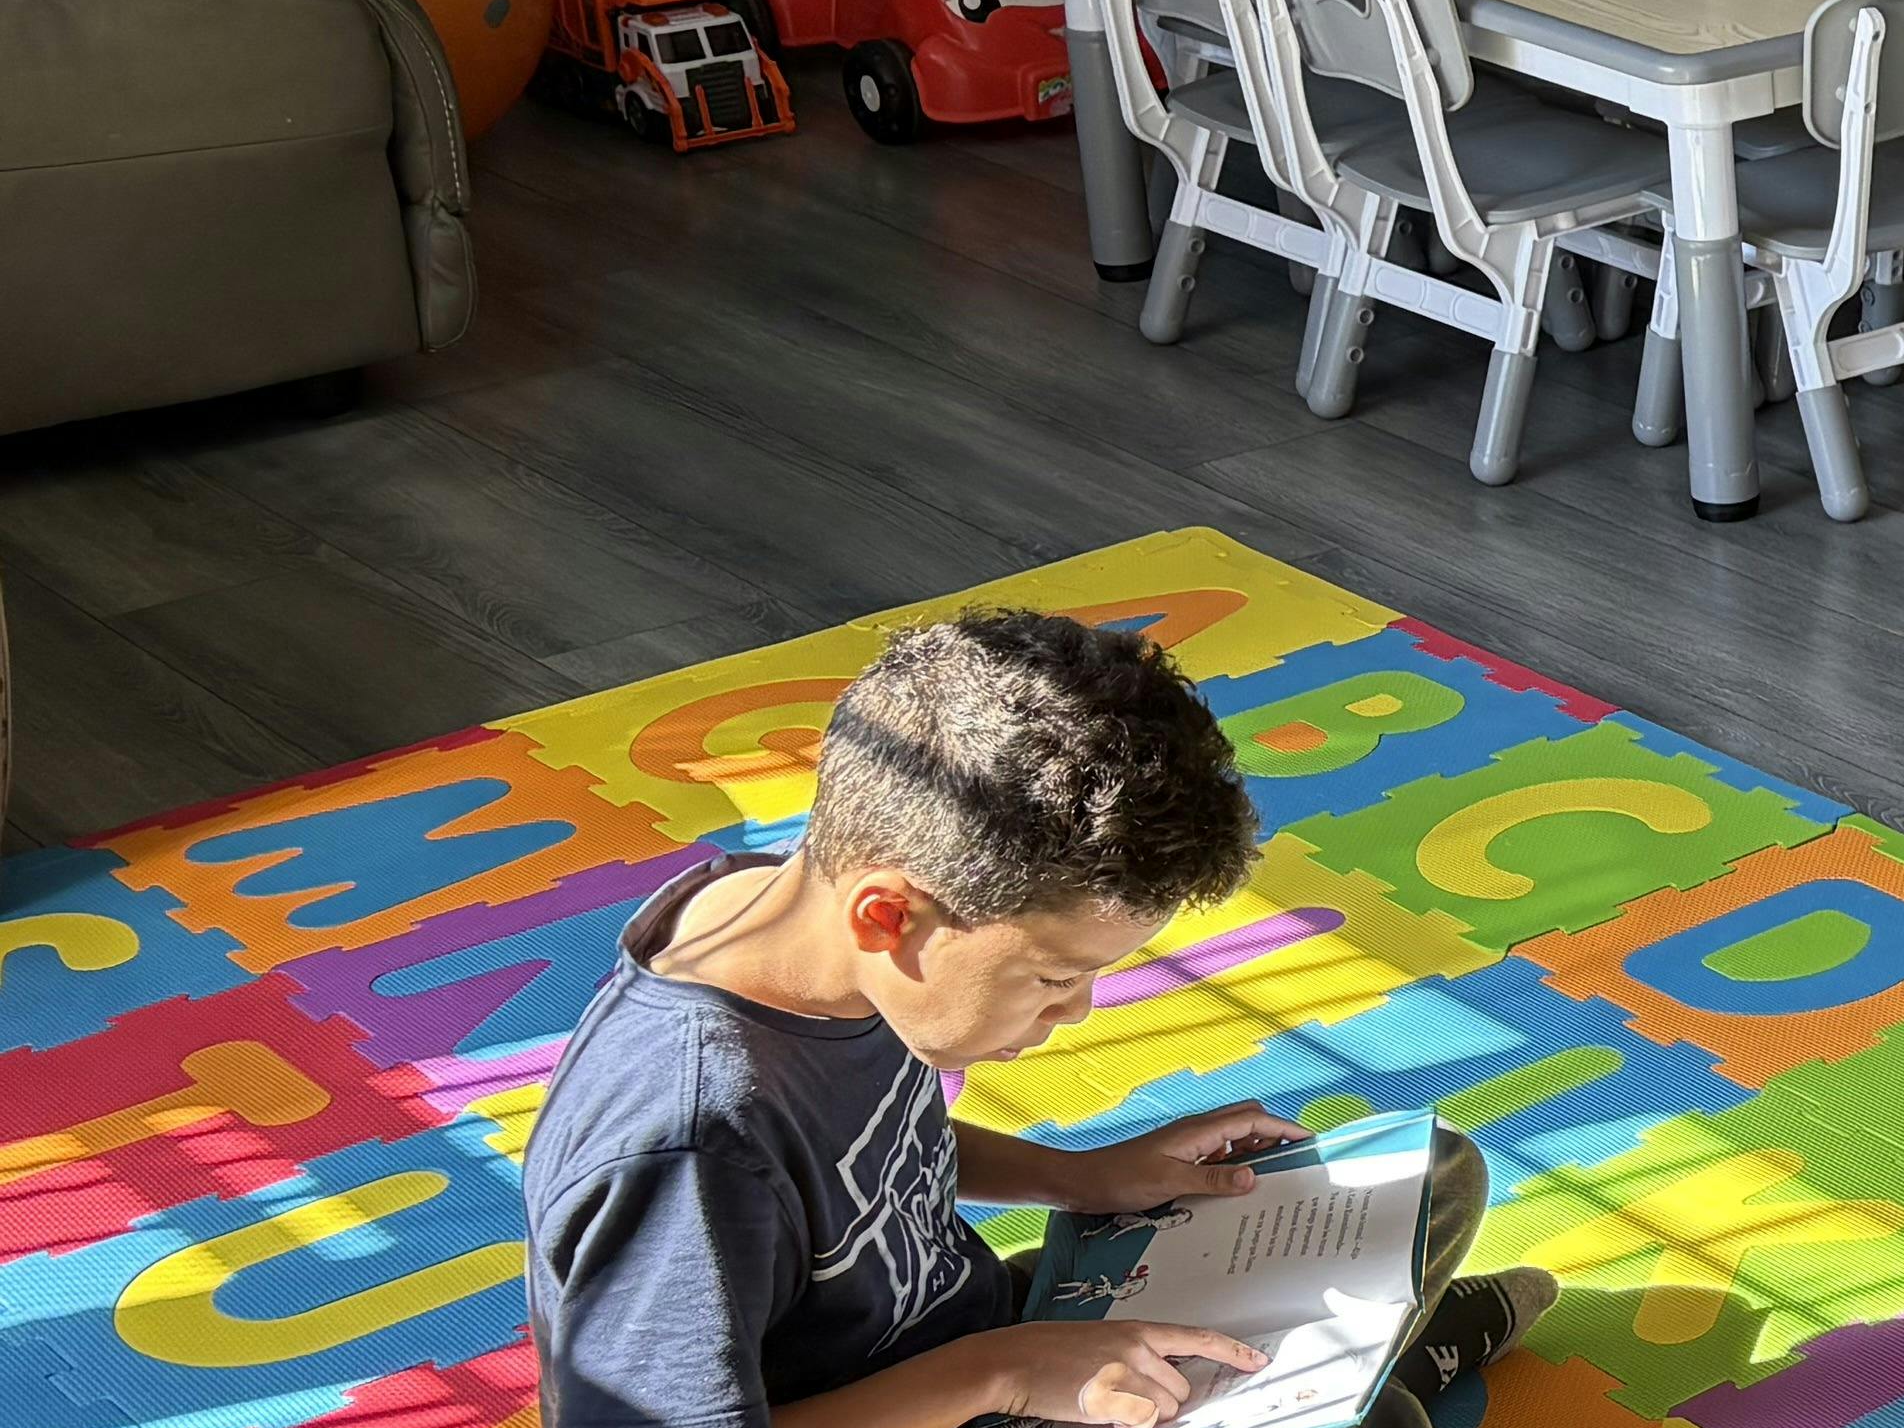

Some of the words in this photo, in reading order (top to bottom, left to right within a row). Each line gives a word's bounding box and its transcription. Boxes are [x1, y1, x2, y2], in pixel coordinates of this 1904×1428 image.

[1216, 671, 1465, 777] B
[1416, 777, 1713, 900] C
[113, 1170, 530, 1367] U
